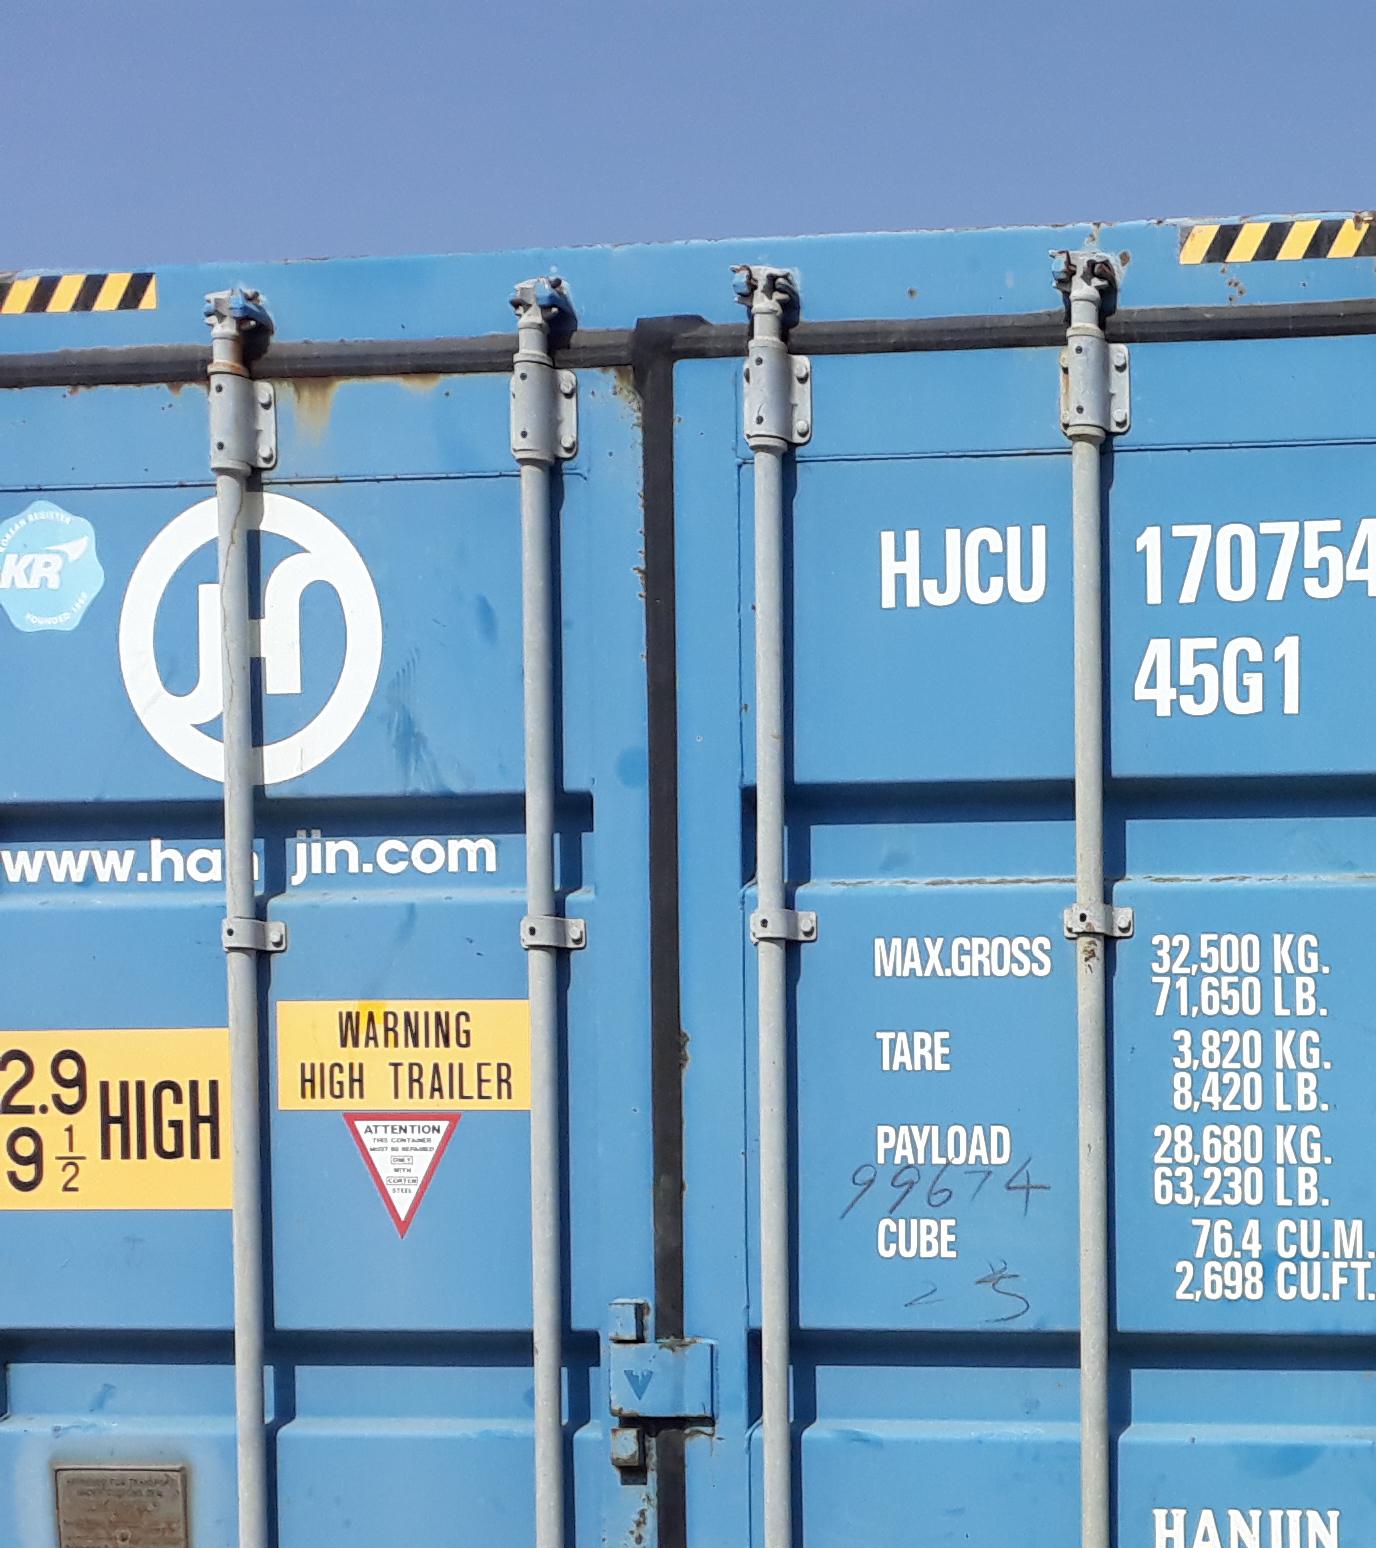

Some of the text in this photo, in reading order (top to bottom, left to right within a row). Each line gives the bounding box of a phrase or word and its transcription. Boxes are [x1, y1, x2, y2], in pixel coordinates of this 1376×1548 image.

[0, 553, 65, 590] KR
[880, 524, 1046, 609] HJCU
[1134, 635, 1300, 717] 45G1
[874, 933, 1330, 977] MAX.GROSS 32,500 KG.
[1151, 975, 1328, 1018] 71,650 LB.
[339, 1011, 471, 1048] WARNING
[875, 1029, 1331, 1074] TARE 3,820 KG.
[0, 1049, 87, 1115] 2.9
[300, 1062, 512, 1100] HIGH TRAILER
[1173, 1072, 1329, 1113] 8,420 LB.
[100, 1079, 220, 1160] HIGH
[364, 1124, 441, 1135] ATTENTION
[876, 1124, 1332, 1168] PAYLOAD 28,680 KG.
[1153, 1166, 1330, 1208] 63,230 LB.
[877, 1218, 1376, 1259] CUBE 76.4 CU.M.
[1175, 1260, 1376, 1302] 2,698 CU.FT.
